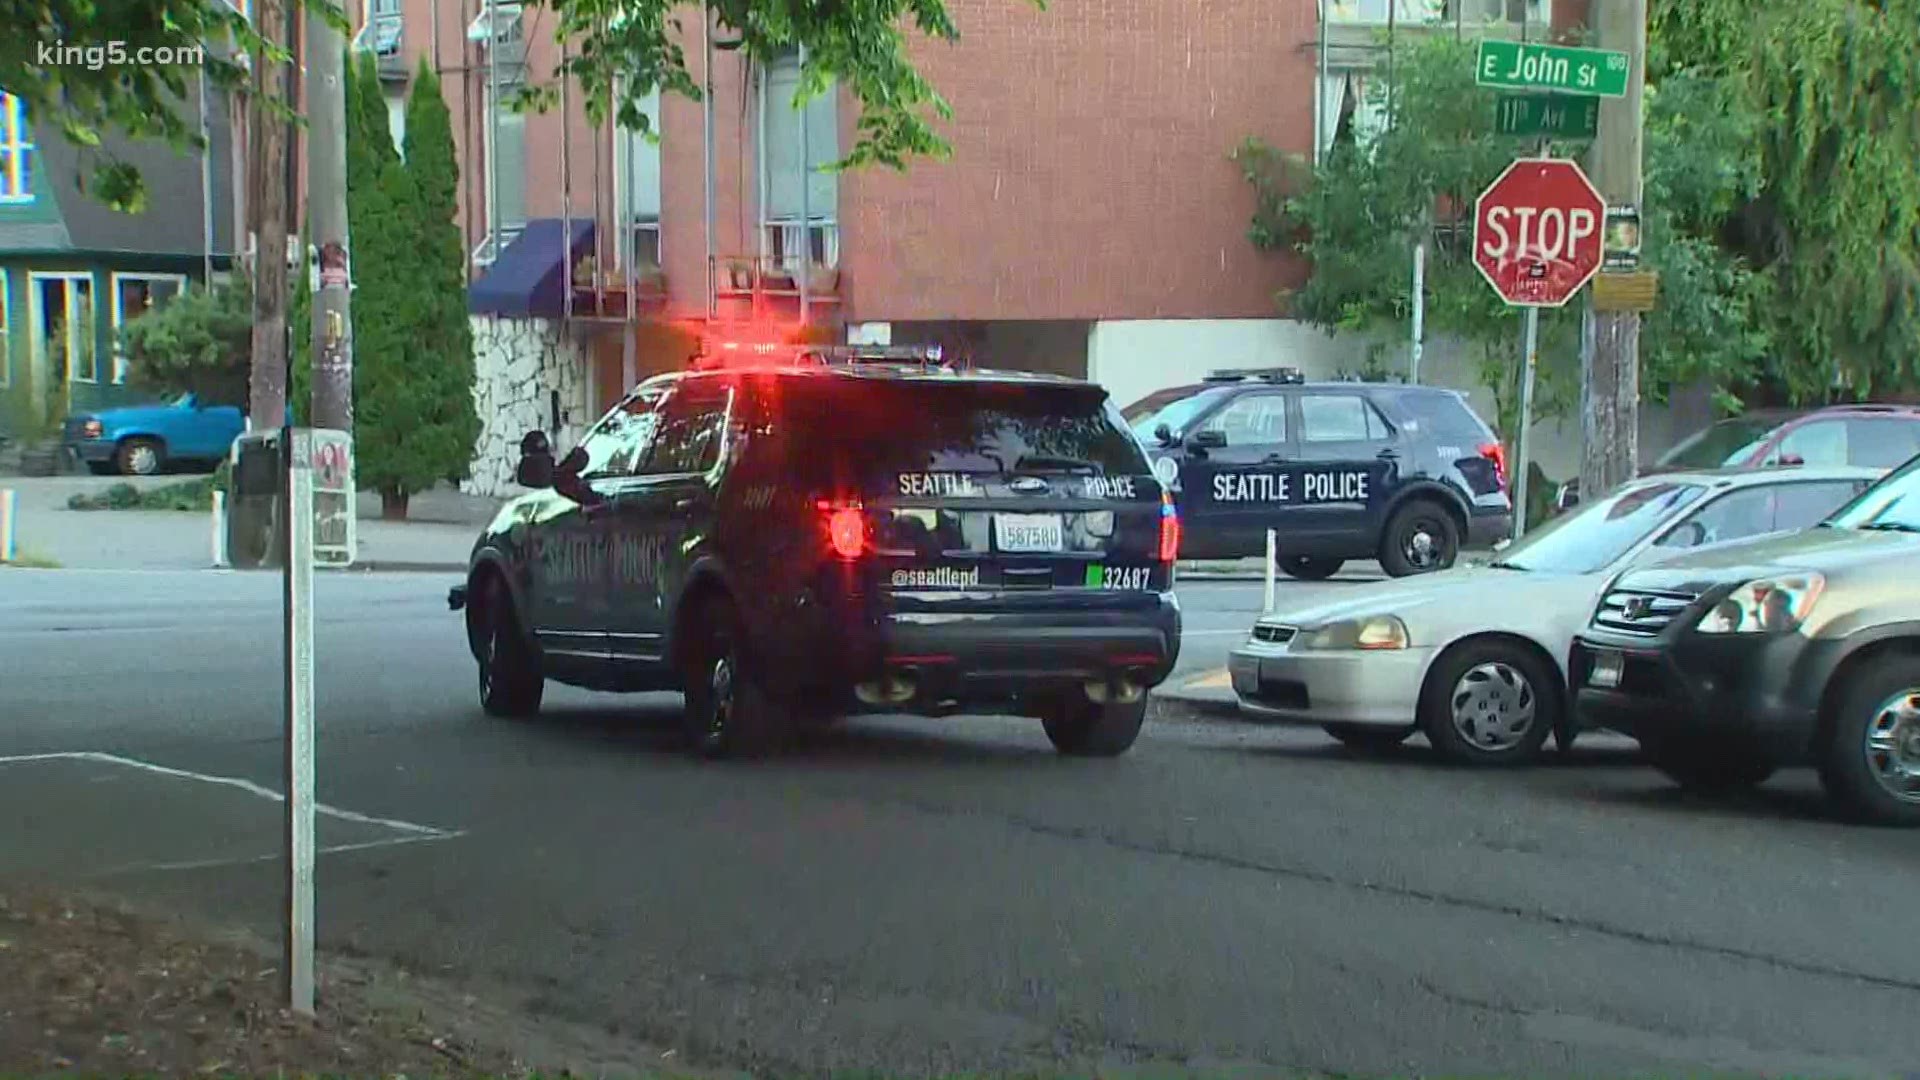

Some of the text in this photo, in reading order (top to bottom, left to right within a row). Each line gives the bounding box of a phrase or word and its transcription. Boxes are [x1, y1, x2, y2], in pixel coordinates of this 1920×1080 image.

[1484, 47, 1597, 87] E John St
[1584, 104, 1596, 129] E
[1483, 205, 1595, 261] STOP
[900, 473, 1137, 498] SEATTLE POLICE
[1213, 472, 1369, 501] SEATTLE POLICE
[891, 565, 979, 592] @seattlepd
[1102, 566, 1151, 590] 32687
